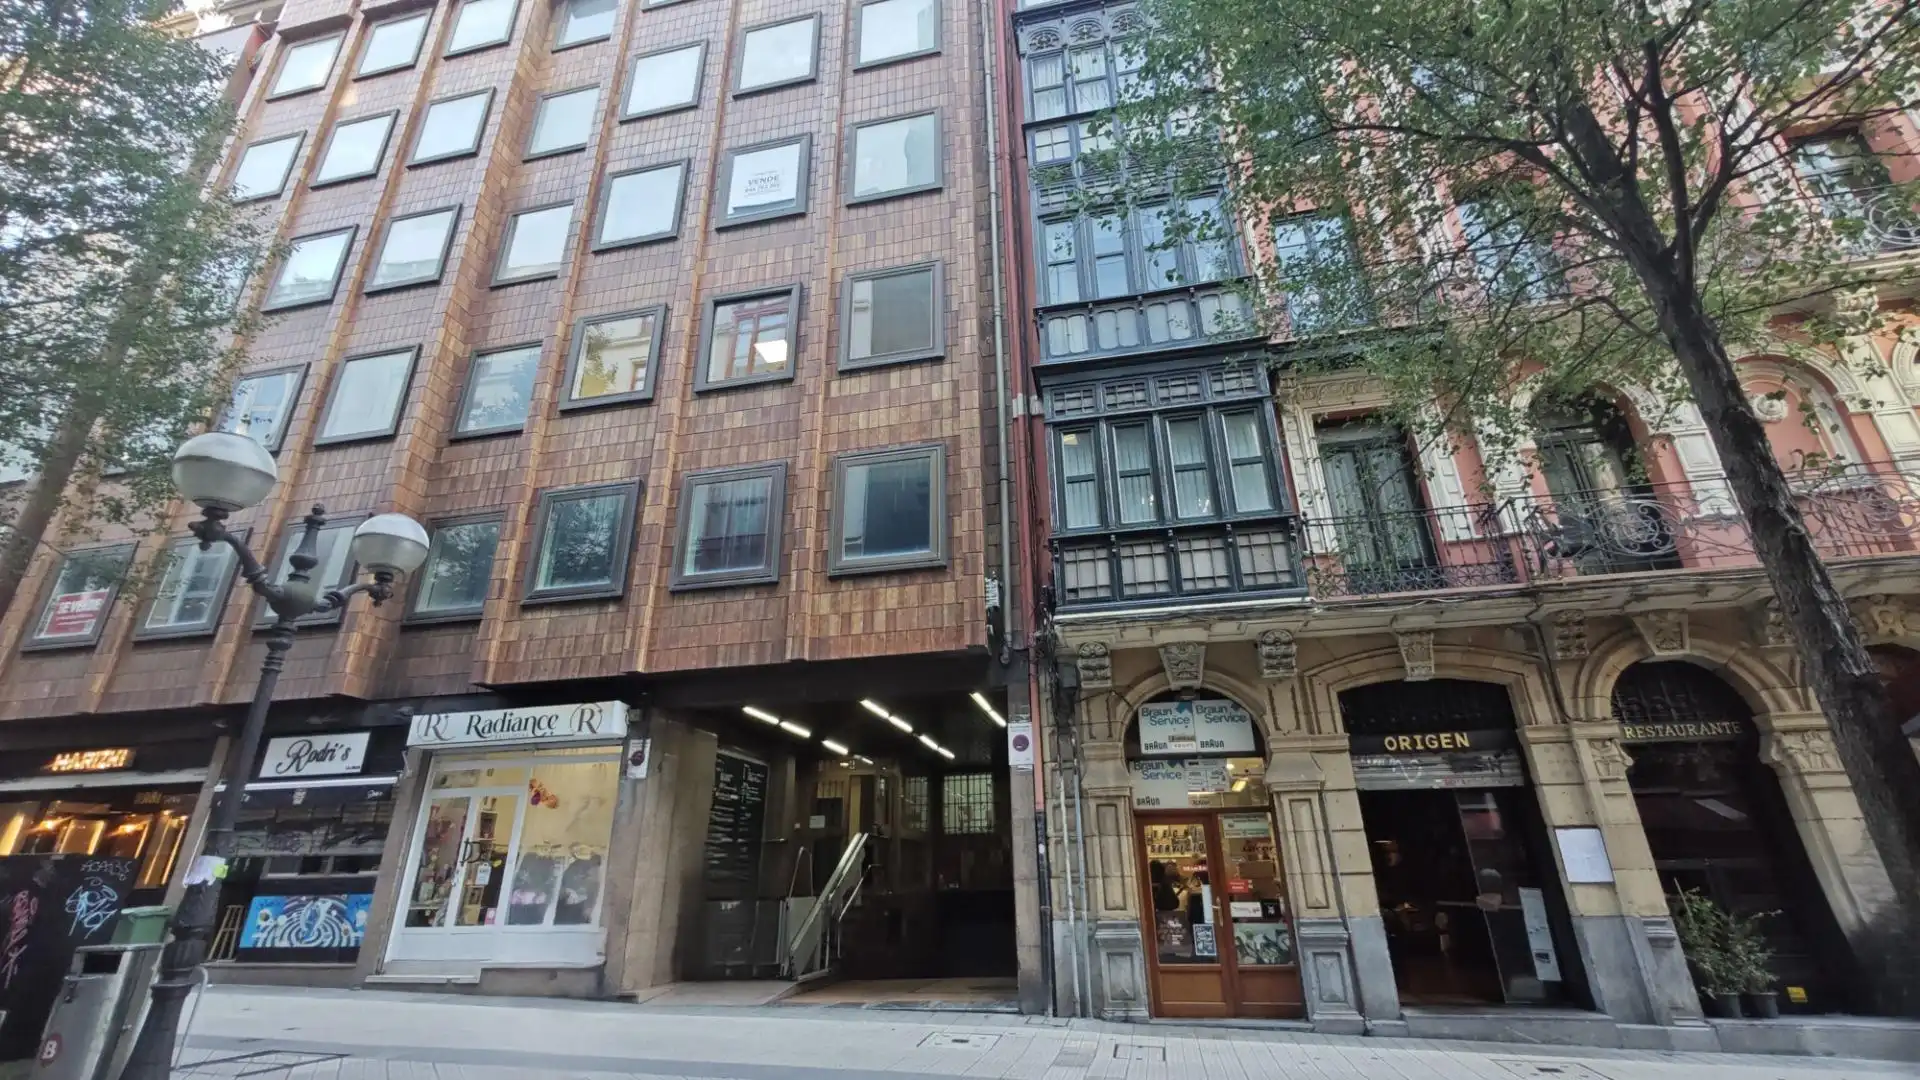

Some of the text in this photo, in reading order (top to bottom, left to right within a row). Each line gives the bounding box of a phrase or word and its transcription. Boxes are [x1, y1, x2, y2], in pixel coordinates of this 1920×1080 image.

[1141, 706, 1173, 717] Braun
[1195, 704, 1228, 715] Braun
[1149, 715, 1190, 727] Service
[1204, 713, 1247, 724] Service
[466, 711, 559, 738] Radiance
[1623, 721, 1743, 739] RESTAURANTE
[1144, 740, 1169, 750] BRAUN
[1200, 738, 1225, 749] BRAUN
[1384, 732, 1470, 751] ORIGEN
[1133, 761, 1165, 770] Braun
[1142, 769, 1182, 780] Service
[1136, 796, 1161, 806] BRAUN
[42, 1040, 58, 1060] B
